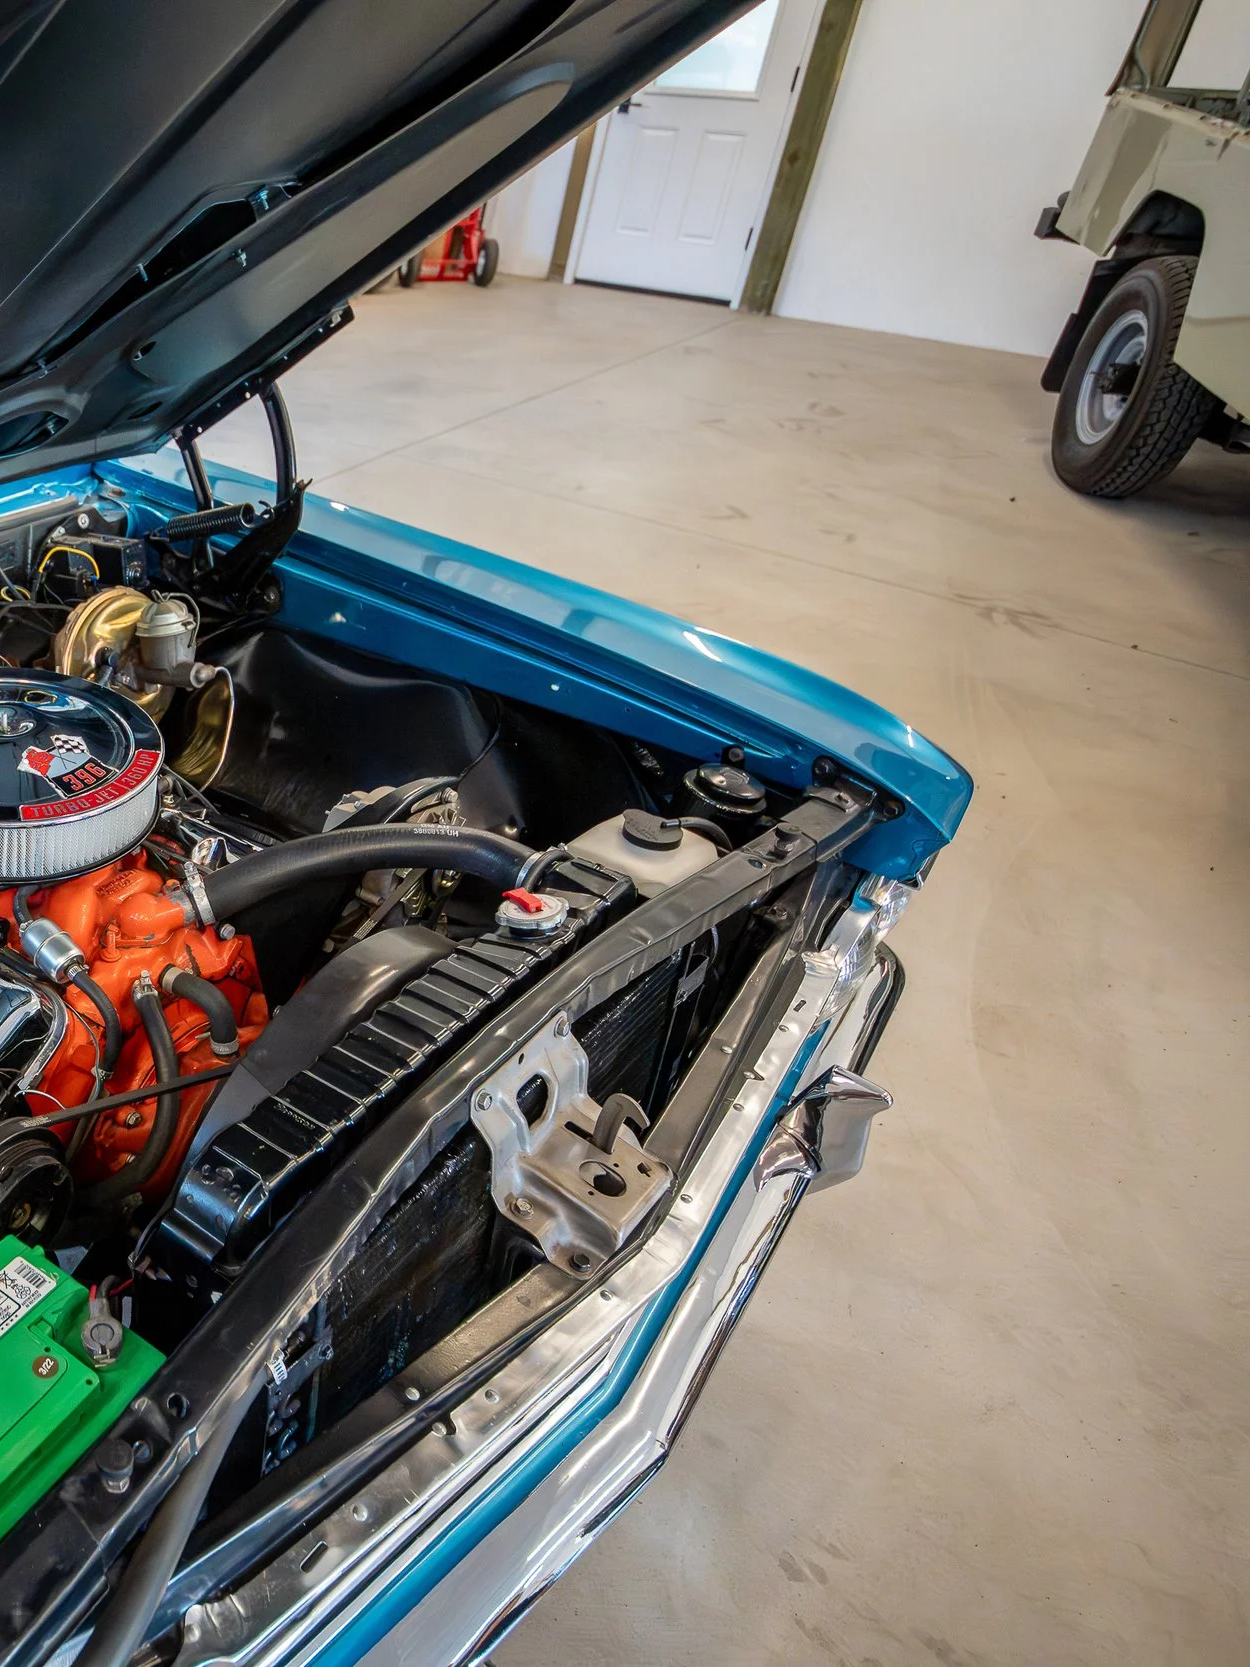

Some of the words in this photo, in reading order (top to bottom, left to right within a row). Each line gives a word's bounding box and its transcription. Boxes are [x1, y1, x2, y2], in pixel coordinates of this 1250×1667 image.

[32, 787, 121, 817] TURBO-JET
[121, 765, 144, 786] 360
[139, 753, 155, 768] HP
[63, 762, 105, 791] 396
[37, 1357, 54, 1375] 3/22
